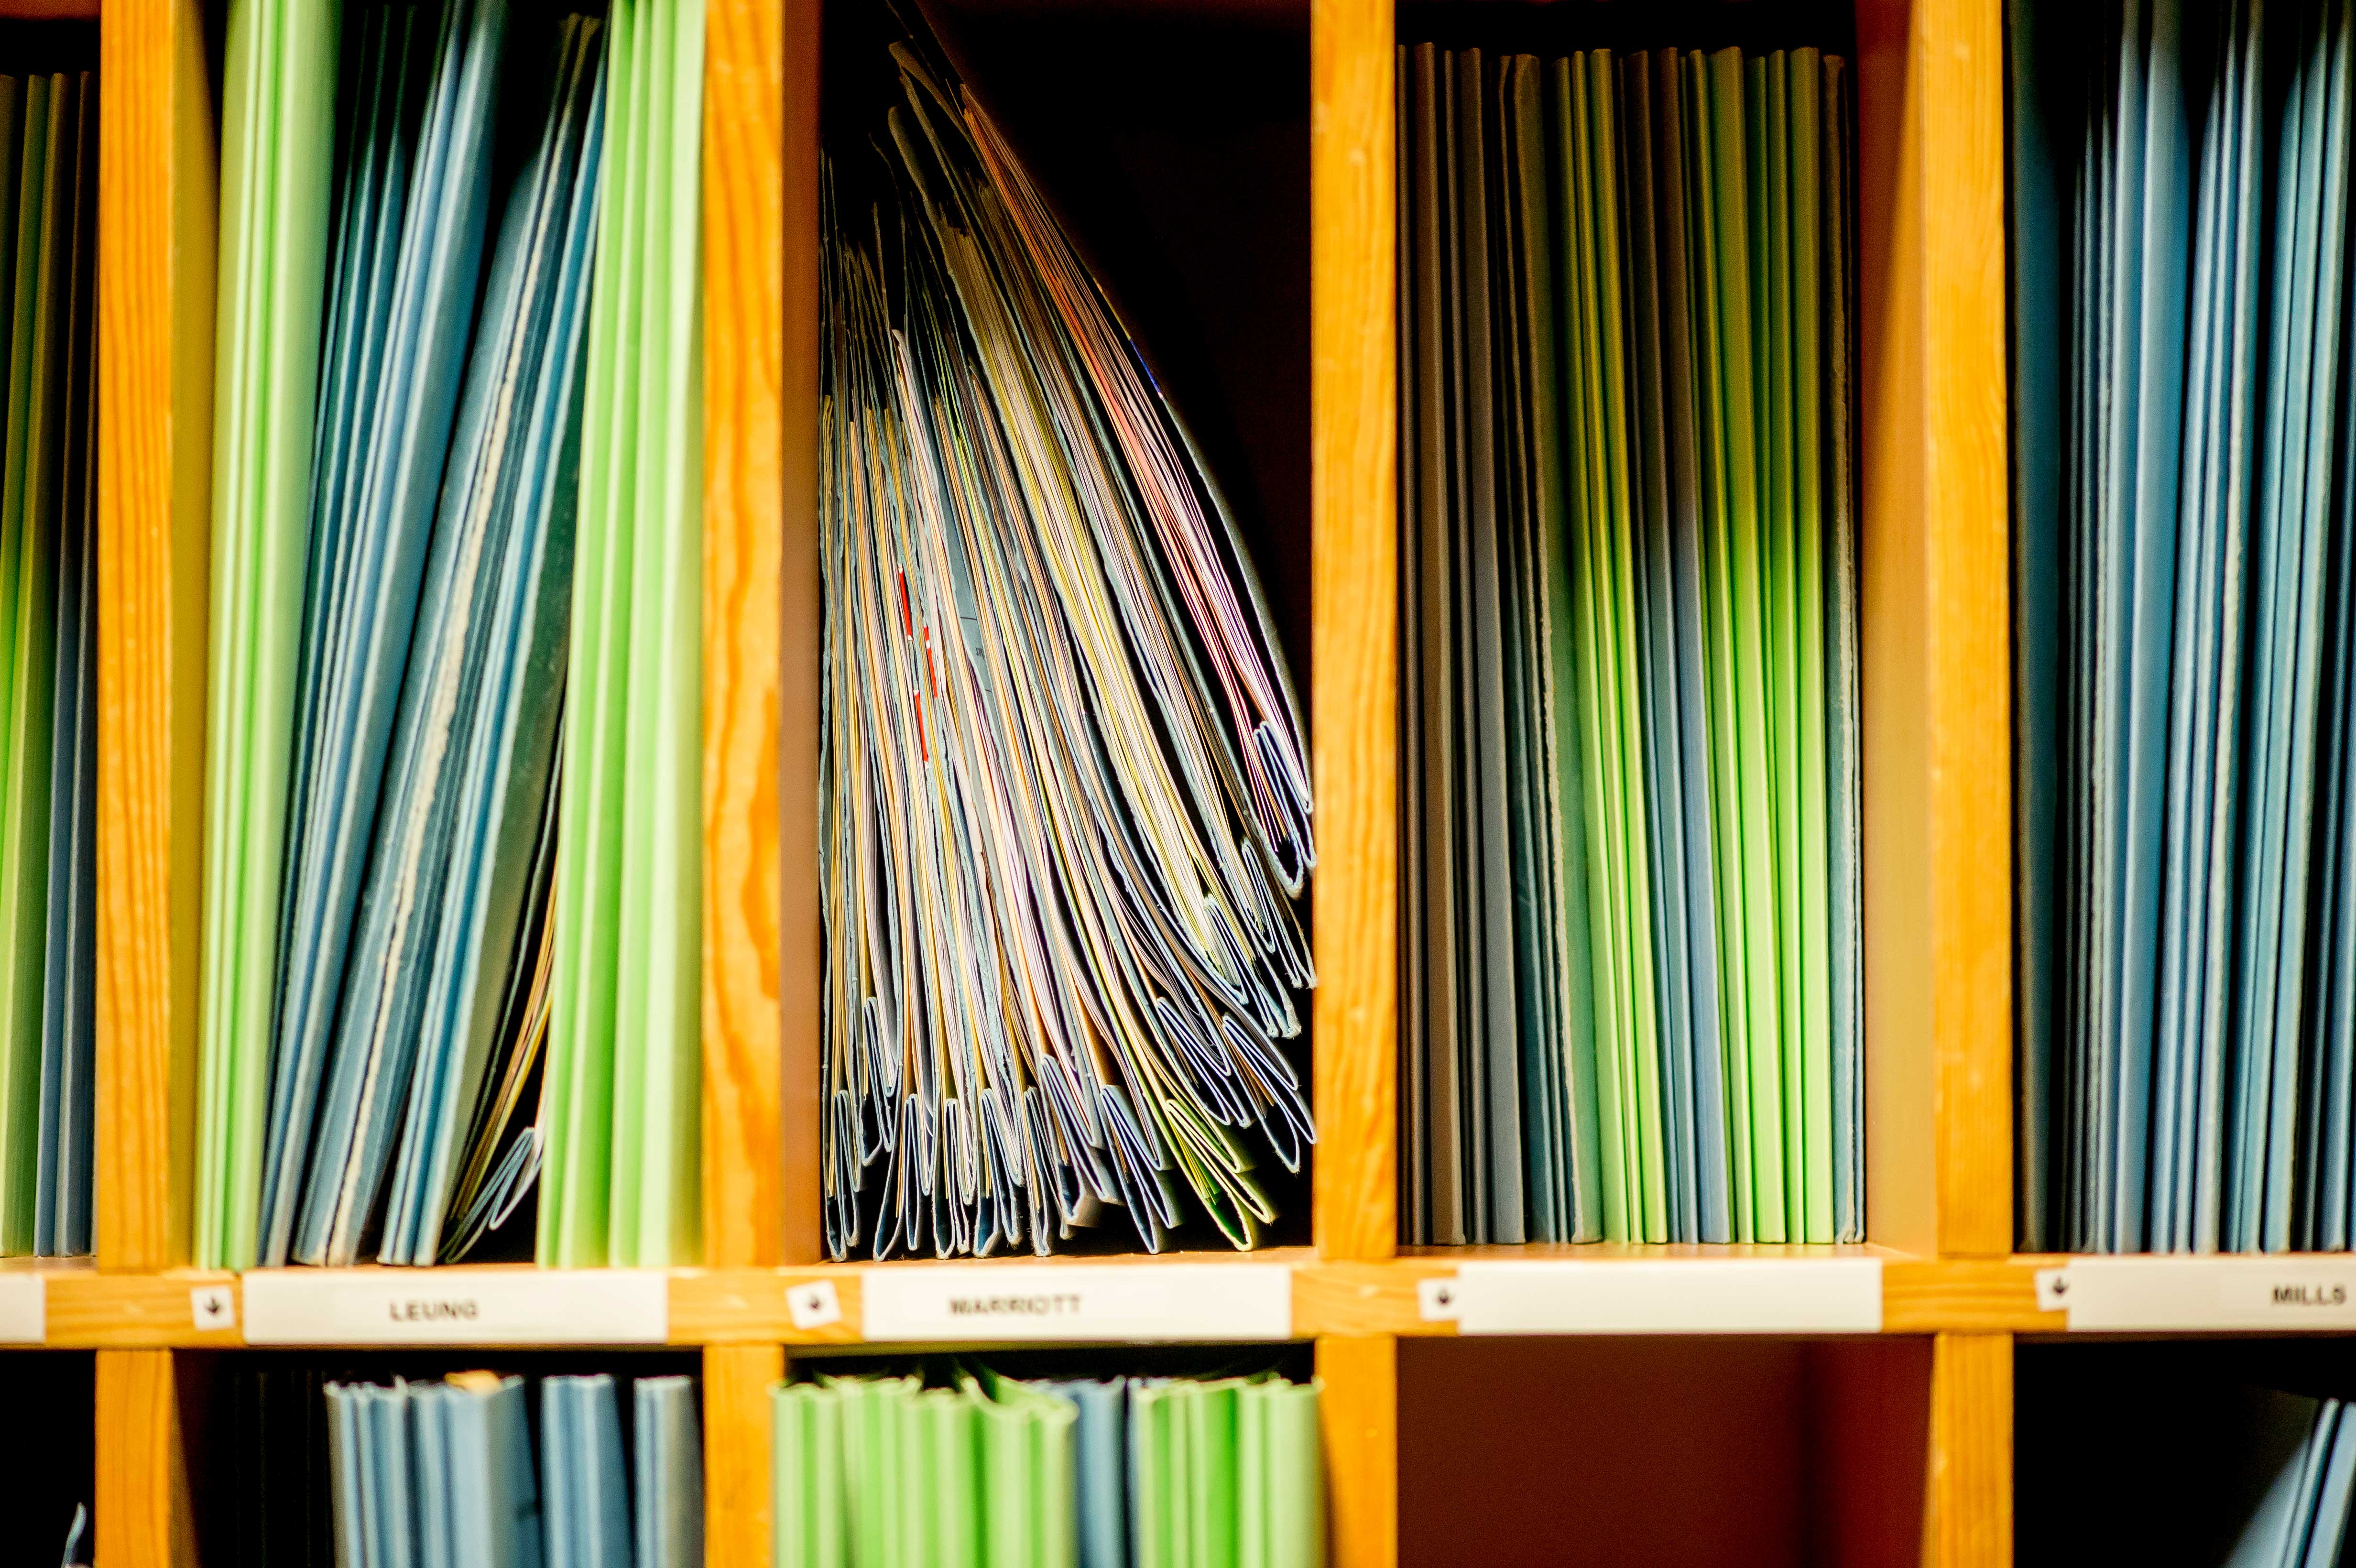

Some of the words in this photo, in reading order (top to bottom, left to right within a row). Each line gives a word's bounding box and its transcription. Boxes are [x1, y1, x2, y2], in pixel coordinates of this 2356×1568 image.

[949, 1293, 1080, 1316] MARRIOTT
[2272, 1285, 2347, 1306] MILLS
[389, 1300, 478, 1321] LEUNG
